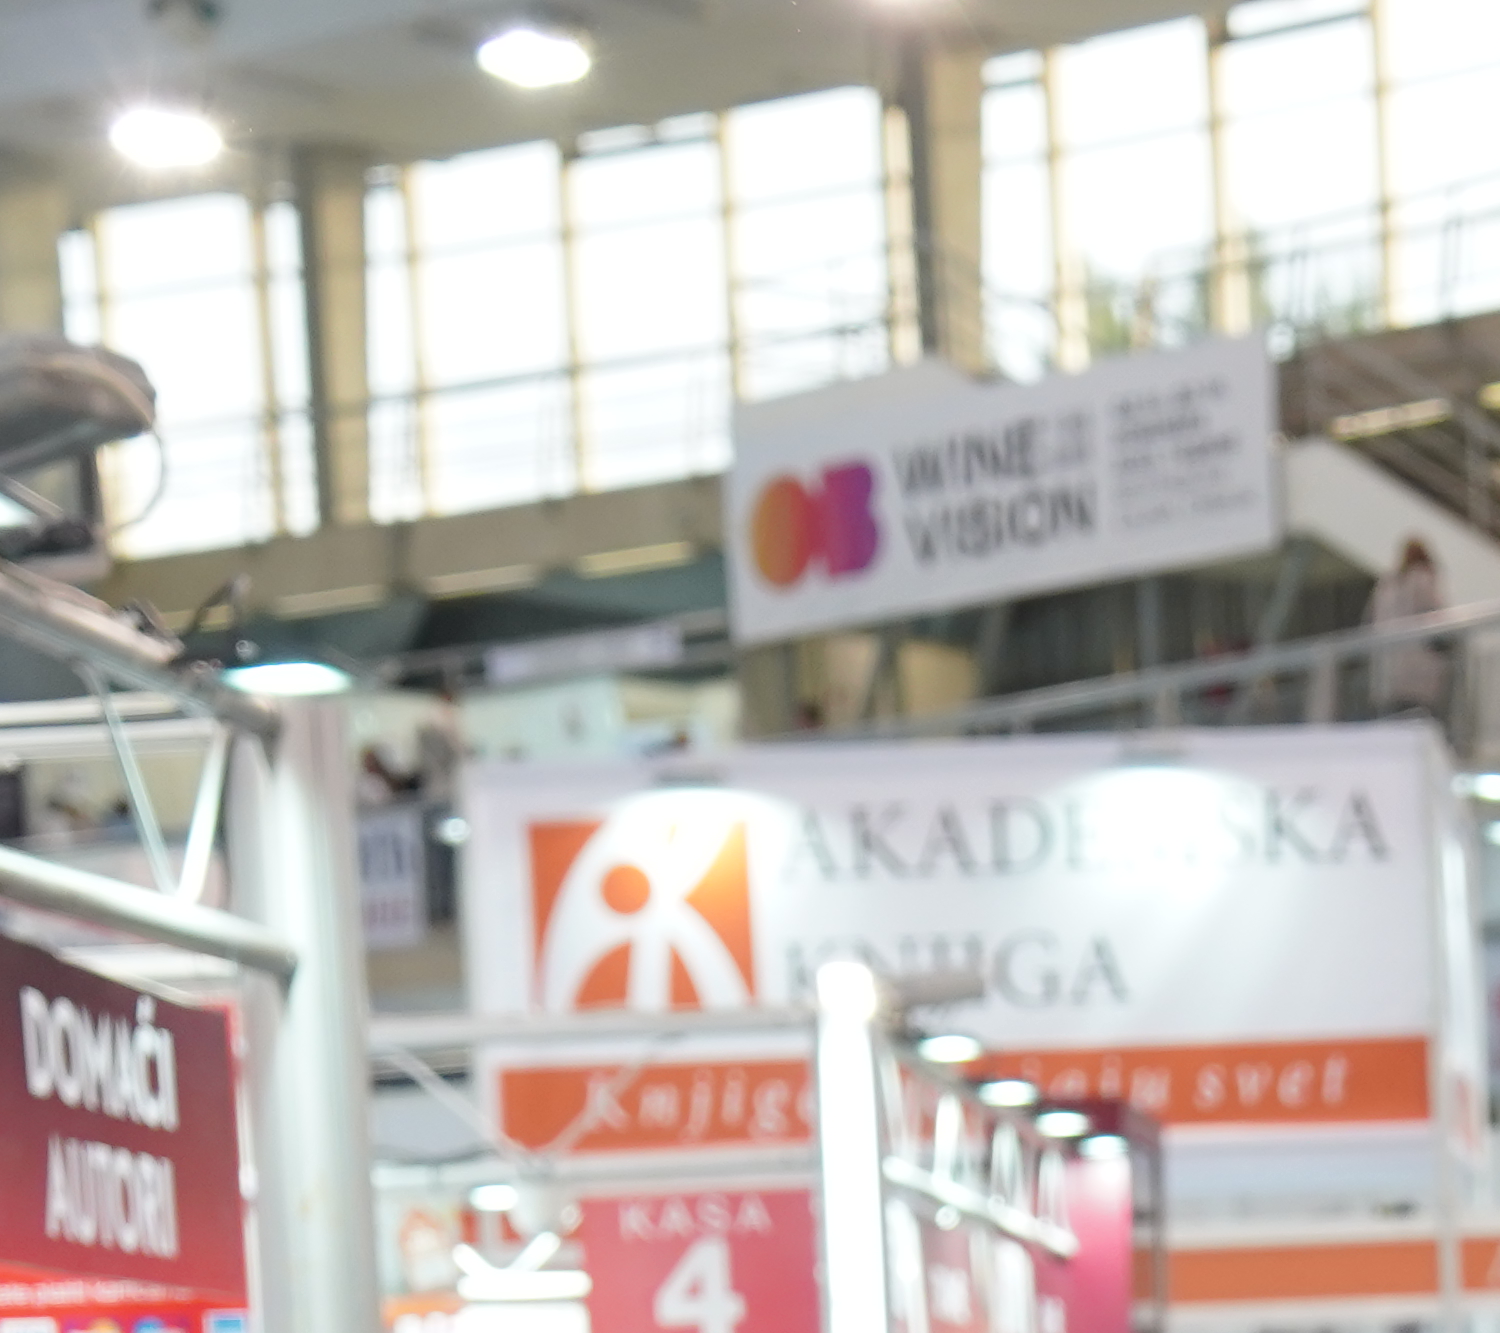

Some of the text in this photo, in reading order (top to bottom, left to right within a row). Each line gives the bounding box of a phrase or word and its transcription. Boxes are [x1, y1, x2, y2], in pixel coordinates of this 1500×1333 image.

[893, 415, 1037, 497] WINE
[903, 492, 1093, 567] VISION
[781, 786, 1393, 880] AKADESKA
[19, 985, 179, 1133] DOMAĆI
[45, 1132, 180, 1260] AUTORI
[619, 1193, 773, 1243] KASA
